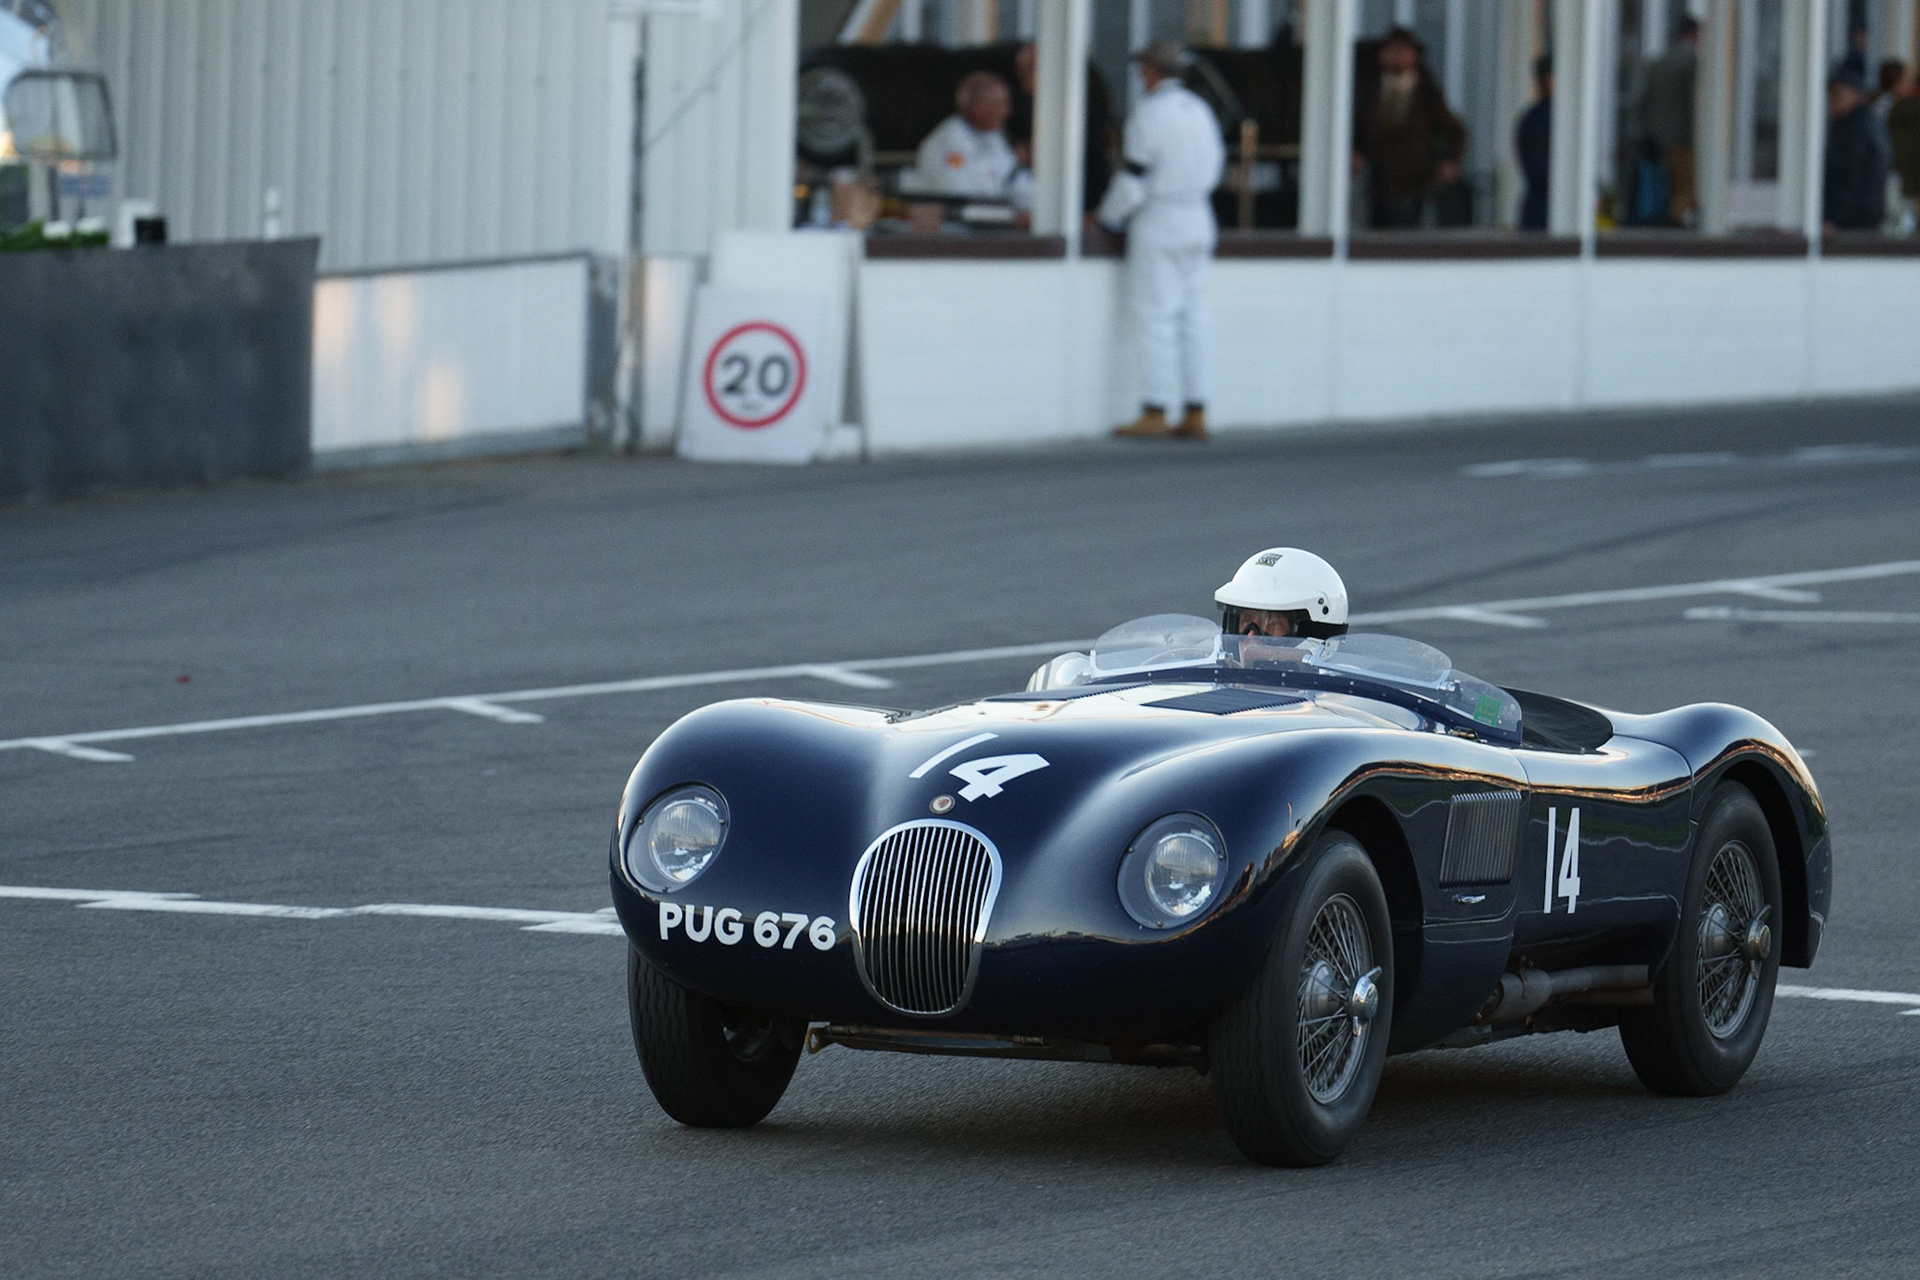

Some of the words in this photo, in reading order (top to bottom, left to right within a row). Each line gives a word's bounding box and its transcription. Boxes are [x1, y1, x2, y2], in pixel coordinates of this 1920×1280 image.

[722, 353, 791, 398] 20
[908, 732, 1051, 803] 14
[1543, 806, 1581, 914] 14
[659, 901, 744, 946] PUG
[753, 911, 837, 951] 676
